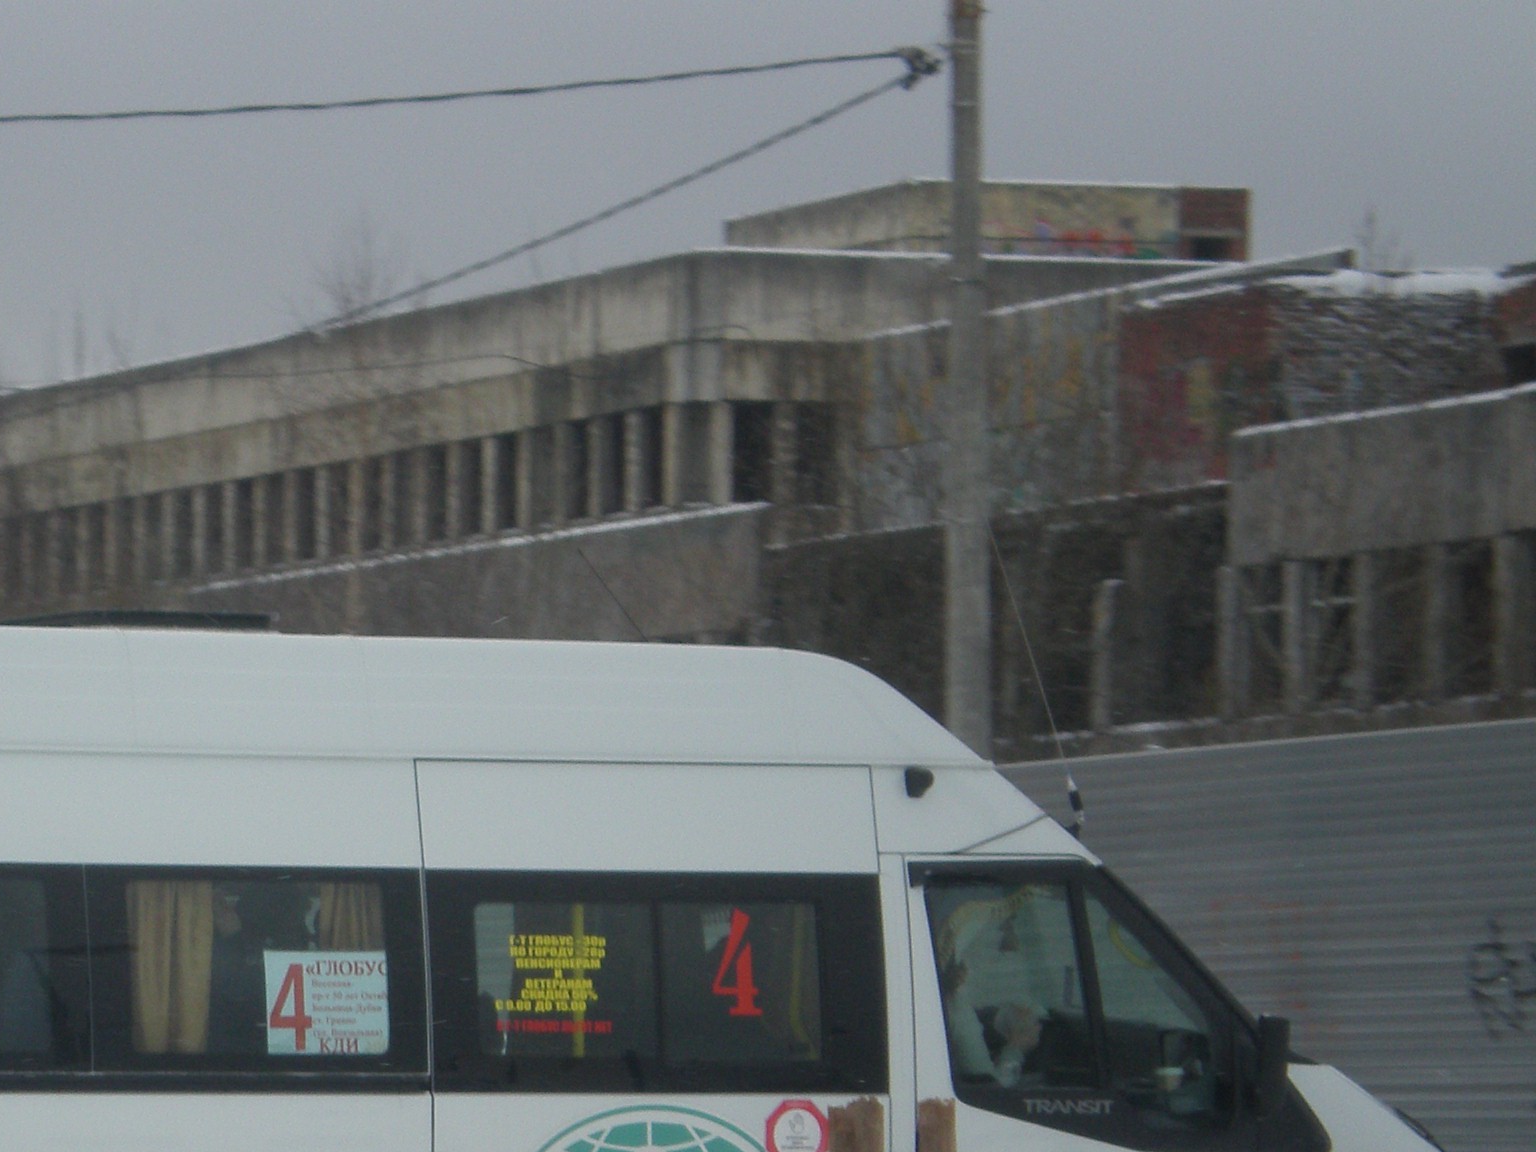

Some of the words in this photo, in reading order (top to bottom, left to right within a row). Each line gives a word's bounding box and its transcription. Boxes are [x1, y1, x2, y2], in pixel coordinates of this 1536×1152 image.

[510, 946, 526, 957] ПО
[529, 946, 574, 958] ГОРОДУ
[712, 907, 763, 1016] 4
[525, 979, 593, 989] ВЕТЕРАНАМ
[521, 989, 571, 1000] СКИДКА
[270, 963, 312, 1051] 4
[535, 1000, 553, 1012] ДО
[1024, 1099, 1114, 1115] TRANSIT
